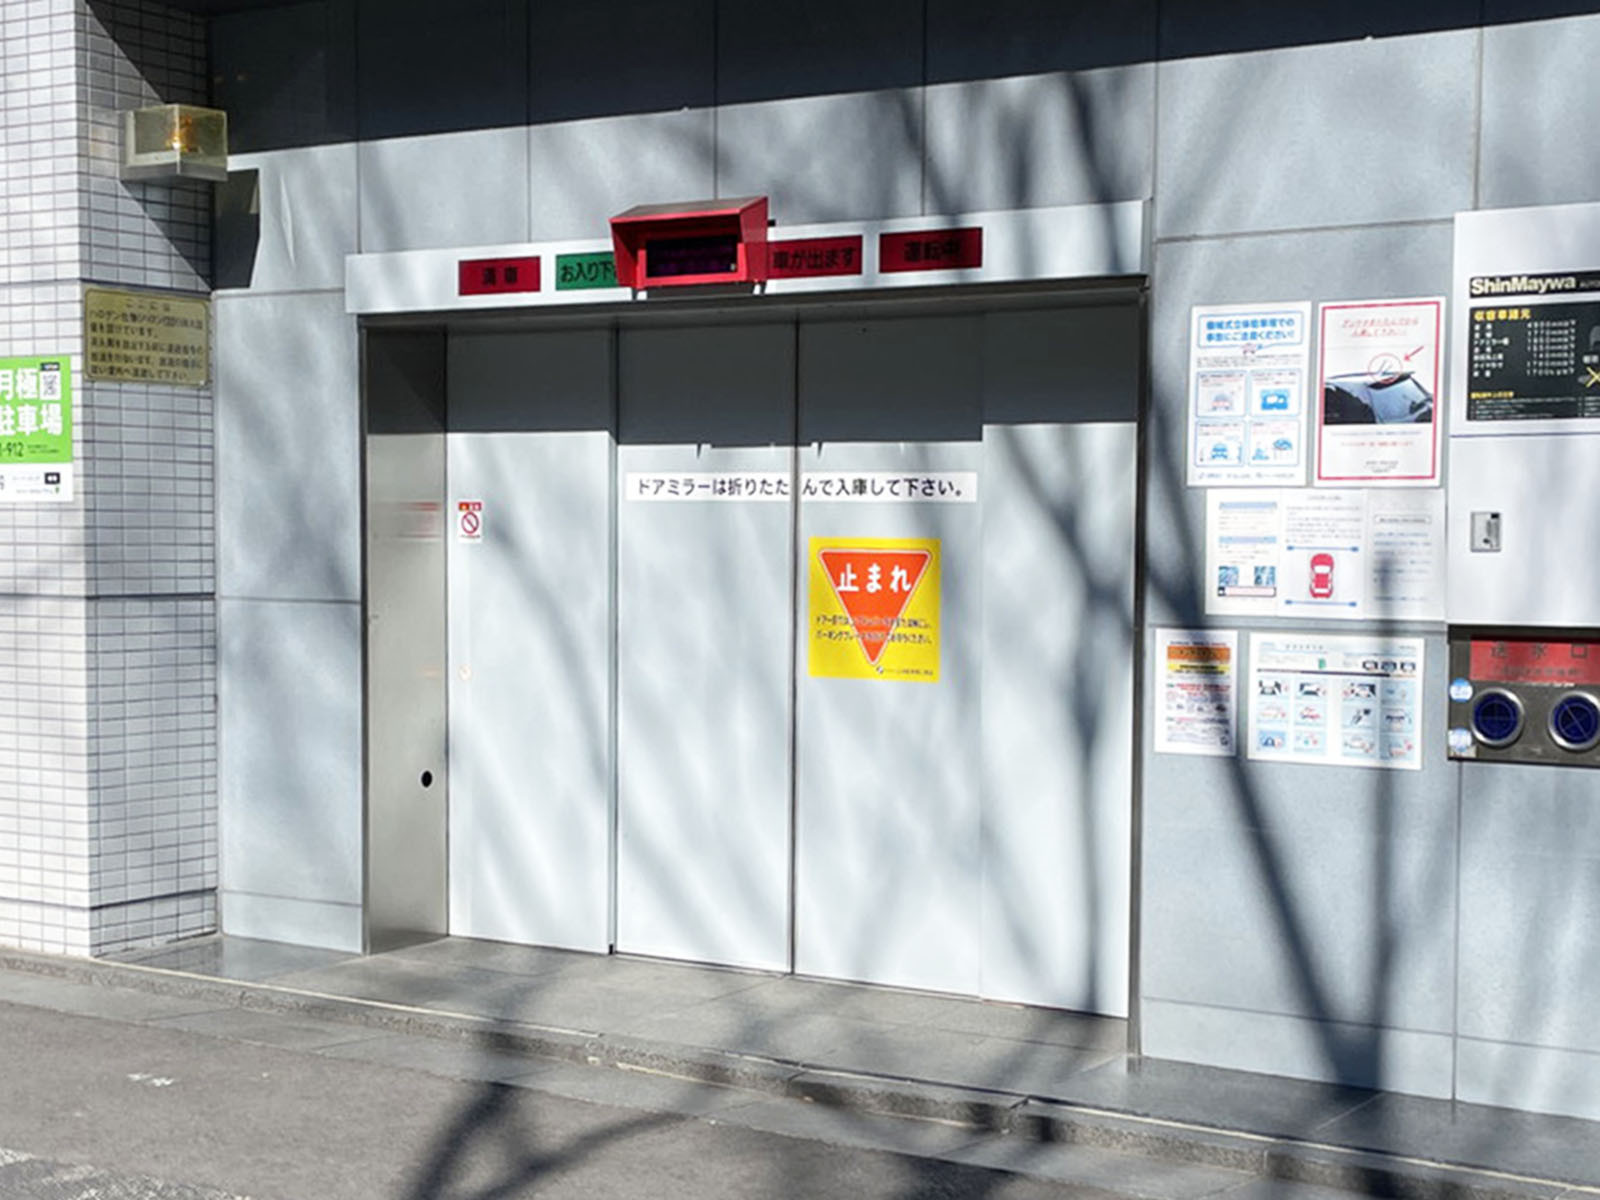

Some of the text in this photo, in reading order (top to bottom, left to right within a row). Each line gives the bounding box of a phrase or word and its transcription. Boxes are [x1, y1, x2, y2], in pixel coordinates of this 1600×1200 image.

[560, 261, 617, 283] お入り下
[1471, 276, 1576, 295] ShinMaywa
[0, 367, 38, 401] 月極
[837, 562, 913, 593] 止まれ
